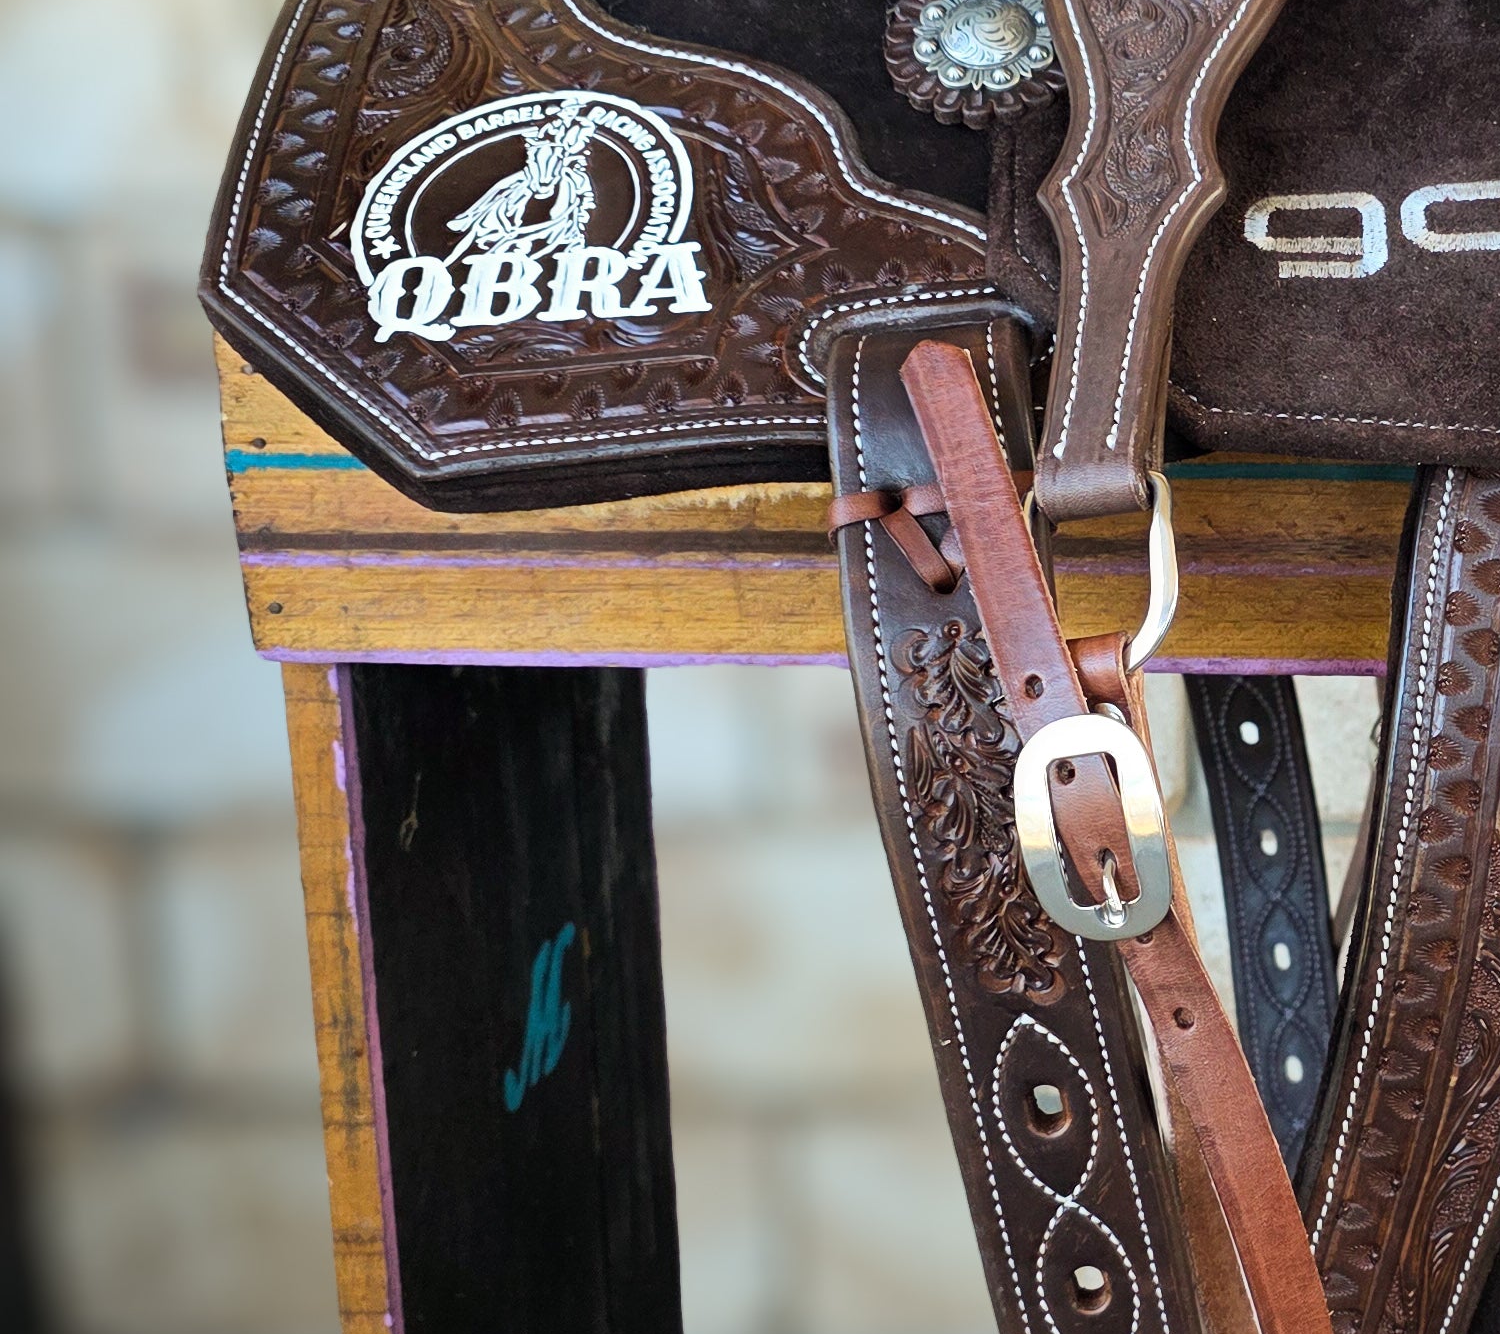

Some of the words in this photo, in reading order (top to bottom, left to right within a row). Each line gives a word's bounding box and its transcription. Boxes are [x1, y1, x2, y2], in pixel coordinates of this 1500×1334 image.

[364, 133, 458, 240] QUEENSLAND
[456, 105, 545, 141] BARREL
[587, 106, 657, 152] RACING
[626, 148, 677, 271] ASSOCIATION
[367, 241, 713, 343] QBRA
